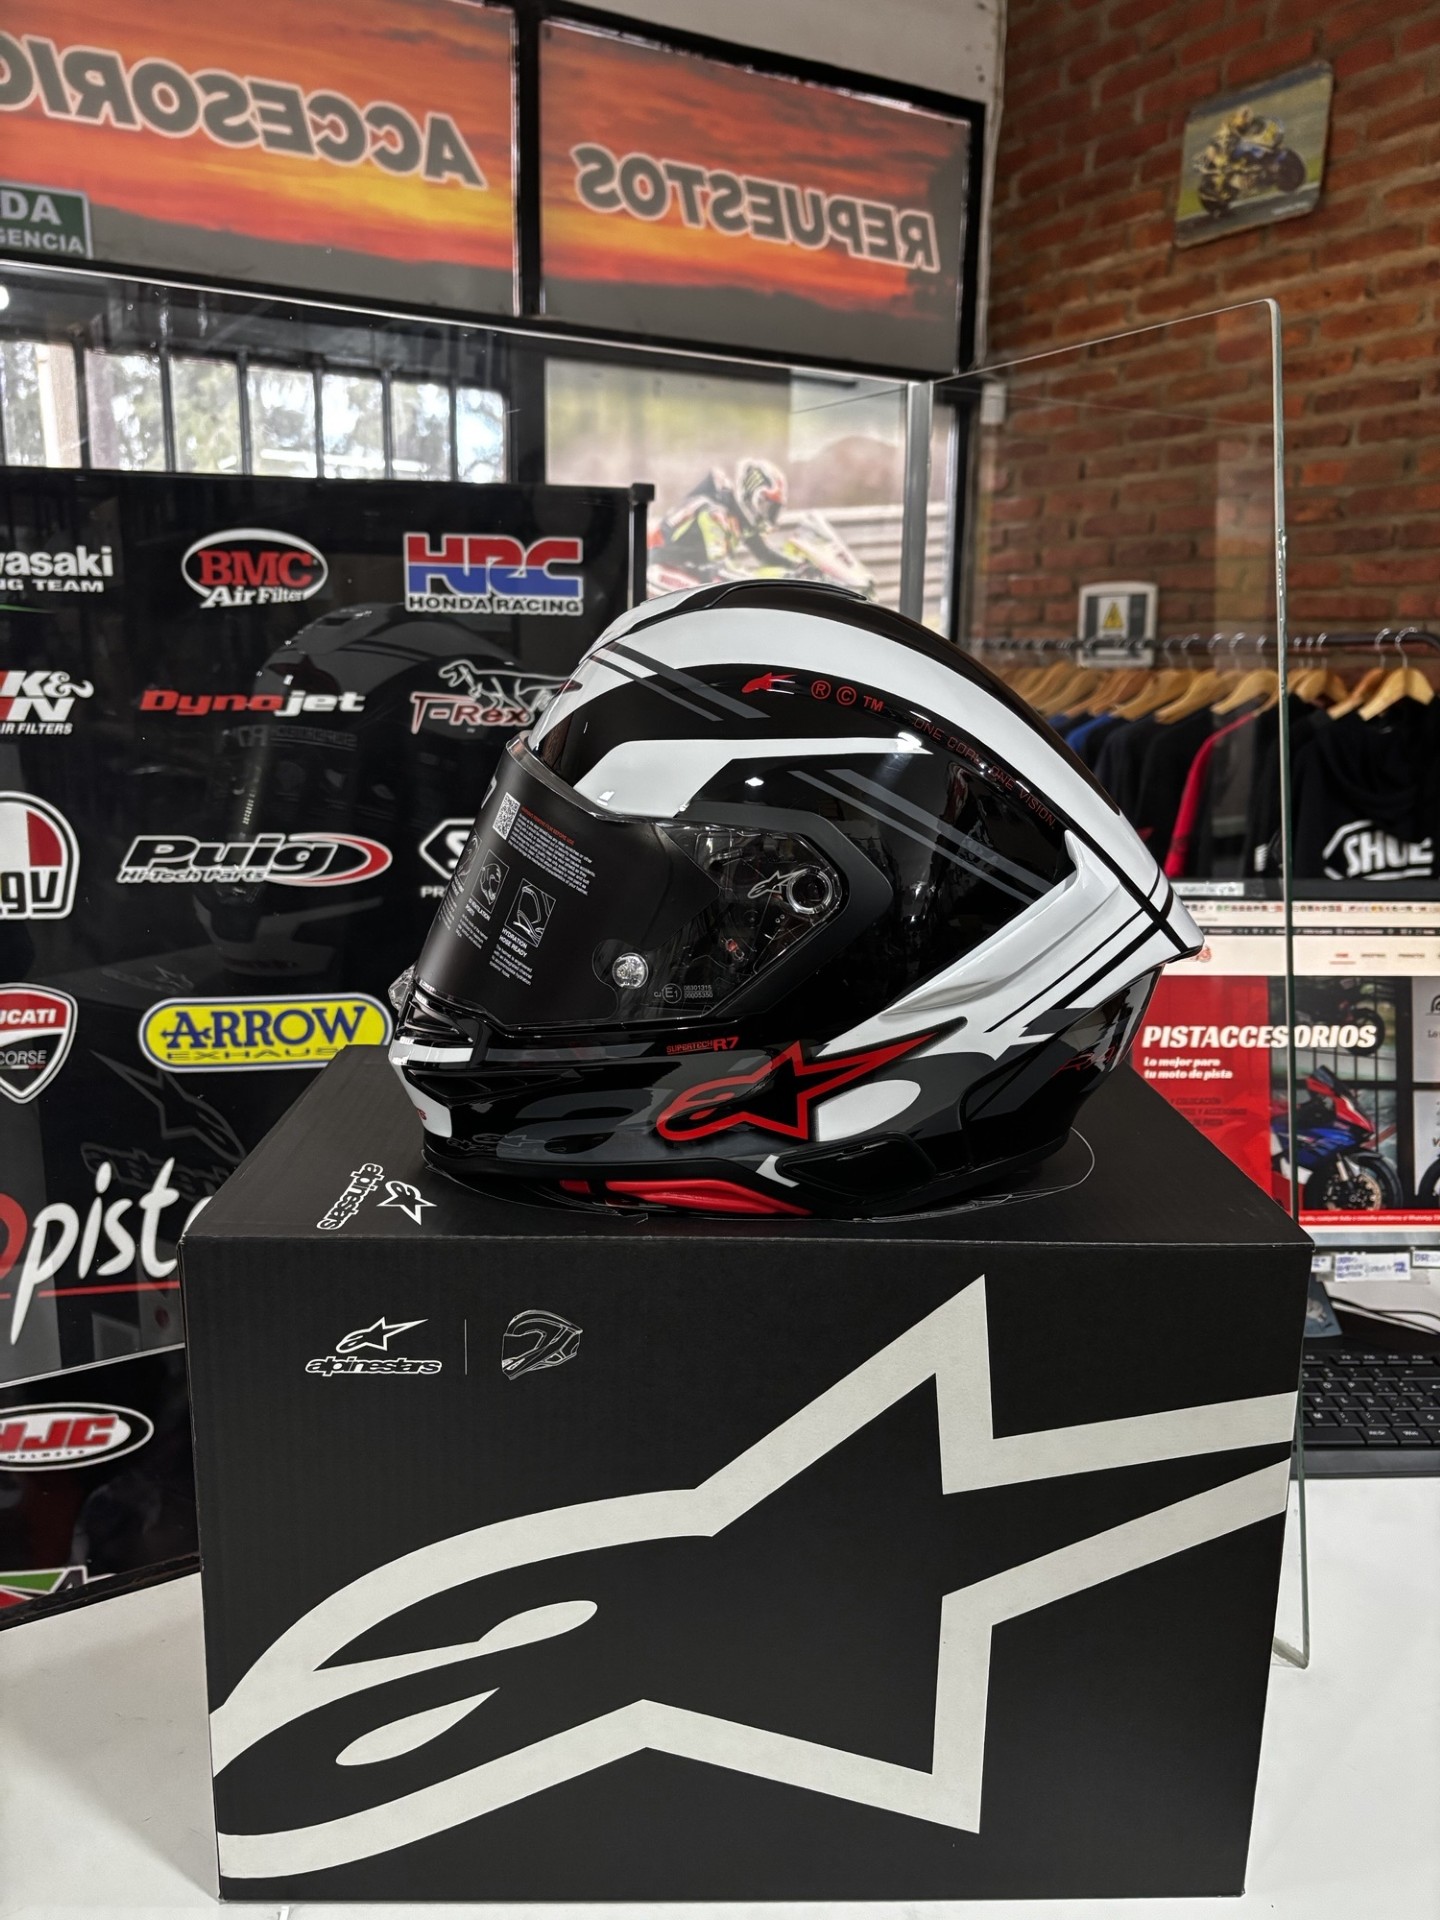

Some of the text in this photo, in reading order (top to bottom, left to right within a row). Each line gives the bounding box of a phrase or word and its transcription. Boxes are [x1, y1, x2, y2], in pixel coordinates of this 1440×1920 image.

[0, 545, 113, 577] asaki
[198, 550, 313, 588] BMC
[405, 532, 583, 598] HRC
[32, 579, 104, 593] TEAM
[199, 585, 305, 609] Air Filter
[408, 597, 582, 614] HONDA RACING
[140, 690, 365, 716] Dynojet
[410, 692, 534, 734] T-Rex
[17, 722, 73, 736] FILTERS
[914, 717, 942, 741] ONE
[989, 765, 1014, 791] ONE
[122, 834, 338, 878] Puig
[118, 868, 268, 883] Hi-Tech Parts
[498, 935, 527, 957] HOSE READY
[500, 928, 528, 948] HYDRATION
[165, 1005, 366, 1049] ARROW
[1142, 1025, 1377, 1049] PISTACCESORIOS
[167, 1047, 338, 1060] EXHAUS
[713, 1036, 739, 1052] R7
[1143, 1056, 1220, 1069] Lo mejor para
[1144, 1068, 1233, 1080] tu moto de pista
[316, 1163, 384, 1230] alpinestars
[305, 1356, 442, 1377] alpinestars
